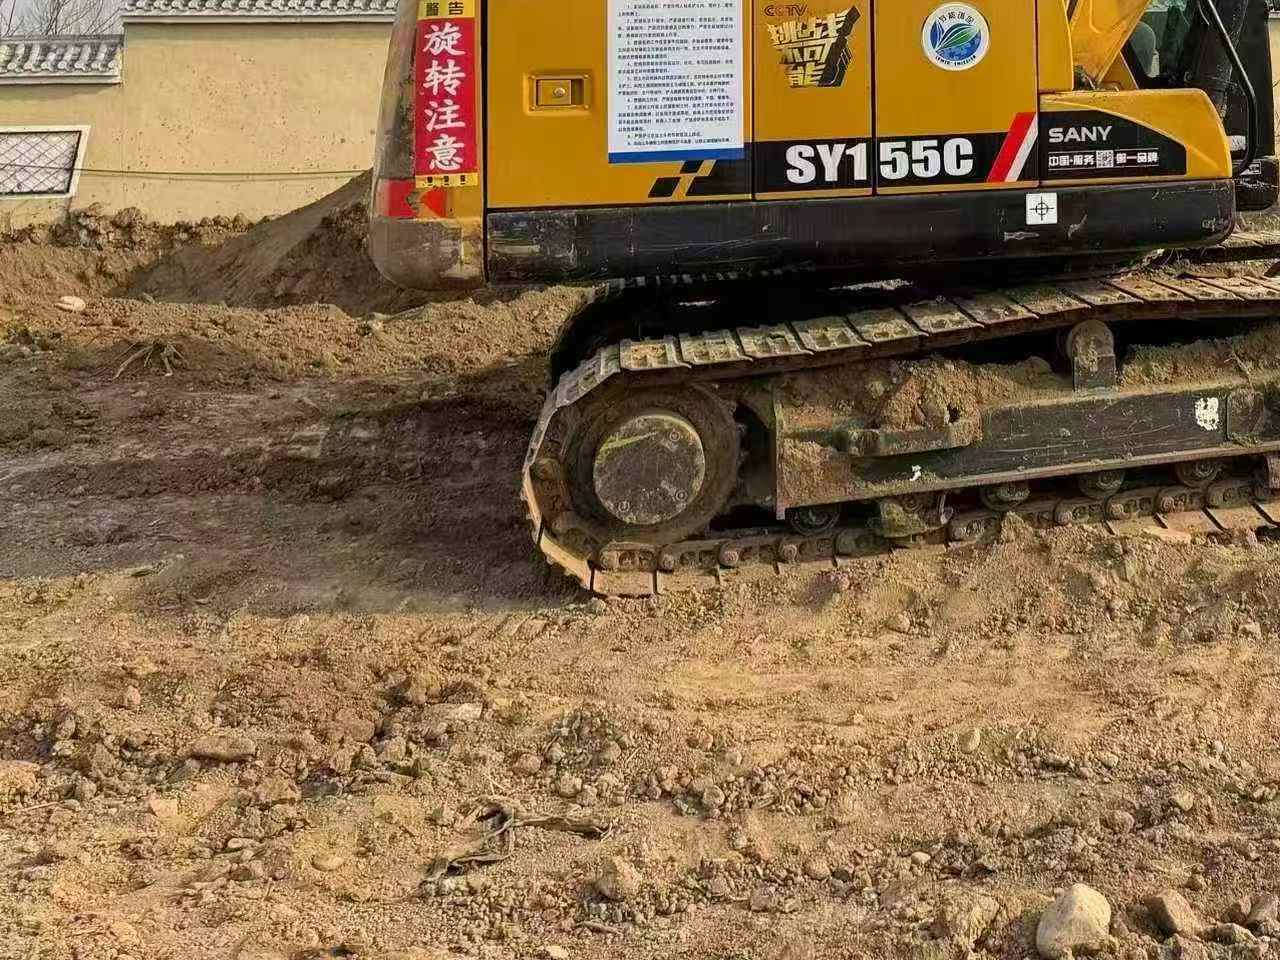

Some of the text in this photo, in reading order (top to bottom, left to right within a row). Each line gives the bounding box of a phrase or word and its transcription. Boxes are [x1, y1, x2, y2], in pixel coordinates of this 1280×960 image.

[426, 1, 465, 17] 警告
[422, 22, 467, 171] 旋转注意
[1048, 125, 1113, 143] SANY
